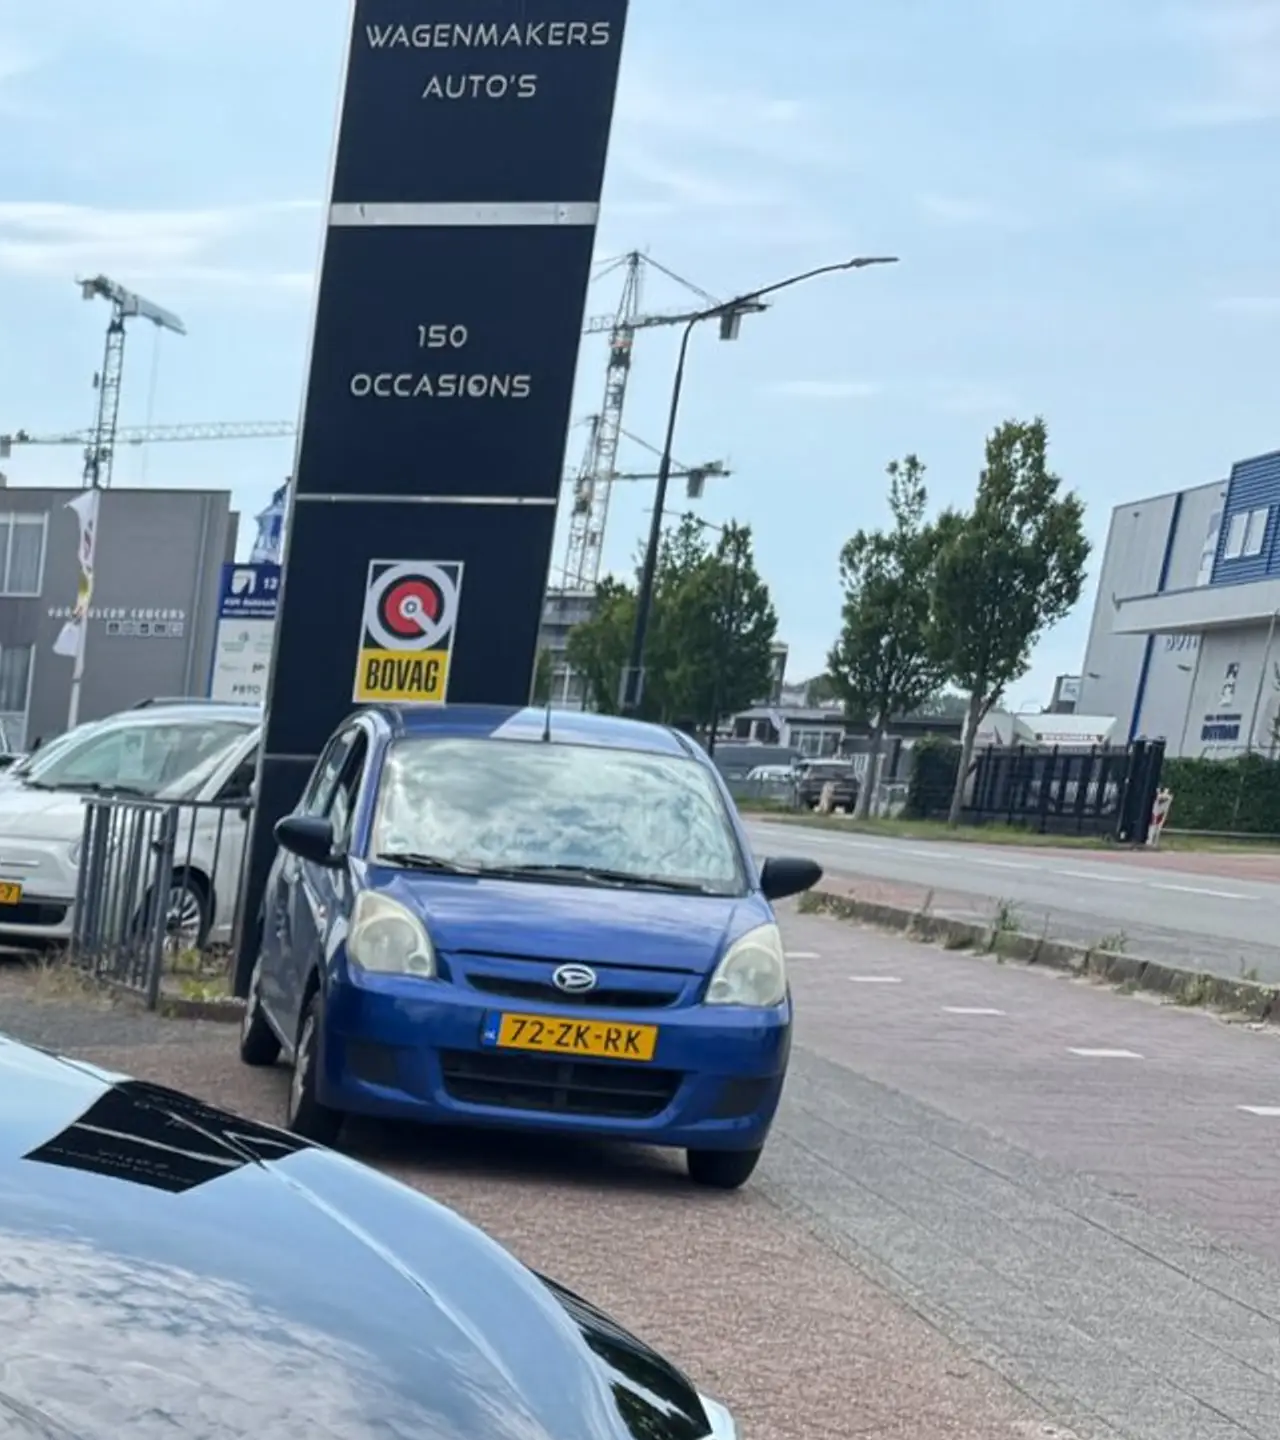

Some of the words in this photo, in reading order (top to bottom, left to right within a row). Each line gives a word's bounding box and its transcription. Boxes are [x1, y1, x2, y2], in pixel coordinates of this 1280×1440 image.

[366, 22, 610, 48] WAGENMAKERS
[422, 74, 537, 98] AUTO'S
[418, 324, 468, 348] 150
[350, 373, 531, 397] OCCASIONS
[365, 658, 439, 693] BOVAG
[509, 1018, 642, 1054] 72-ZK-RK
